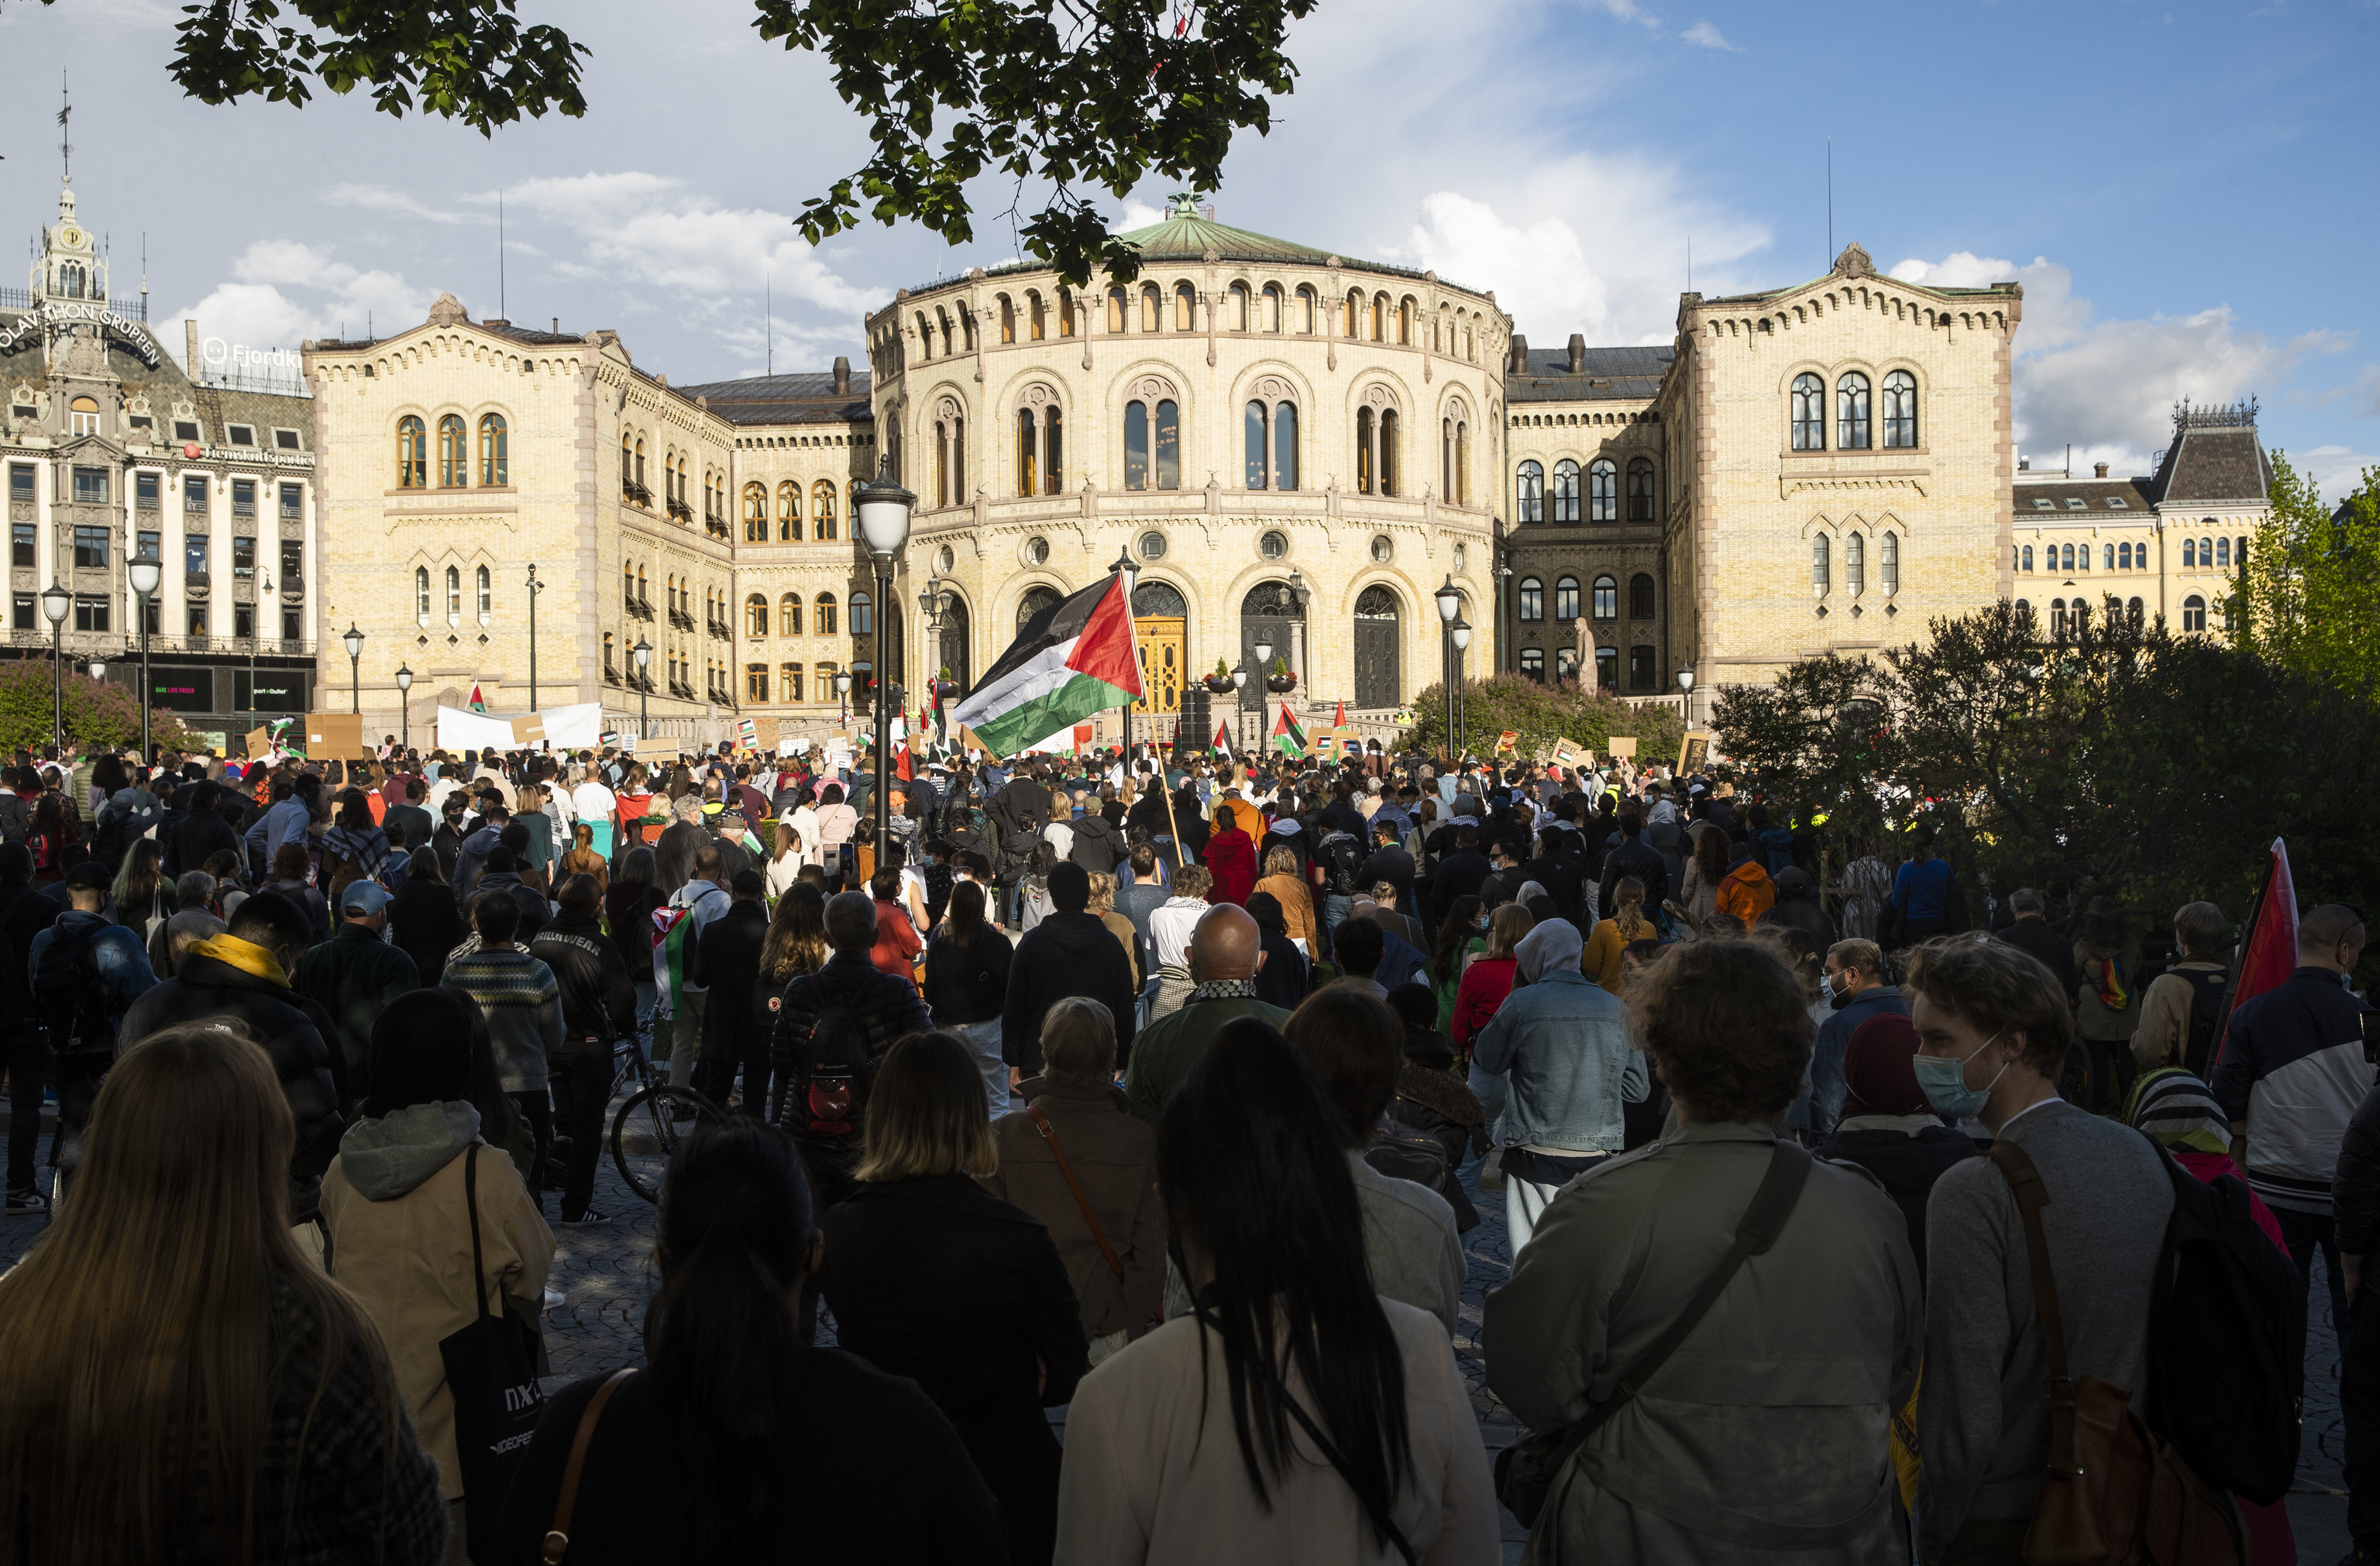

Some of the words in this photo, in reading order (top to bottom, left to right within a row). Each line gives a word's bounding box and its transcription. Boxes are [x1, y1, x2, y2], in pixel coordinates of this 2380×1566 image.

[0, 310, 40, 348] OLAV
[42, 303, 95, 322] THON
[98, 309, 160, 365] GRUPPEN
[756, 718, 771, 727] FROM
[784, 739, 807, 749] FREE
[1559, 742, 1577, 754] JUSTICE
[563, 934, 601, 957] WEAR
[1900, 1409, 1915, 1430] odak
[489, 1430, 535, 1455] VIDEOFES
[1896, 1419, 1919, 1451] OLD
